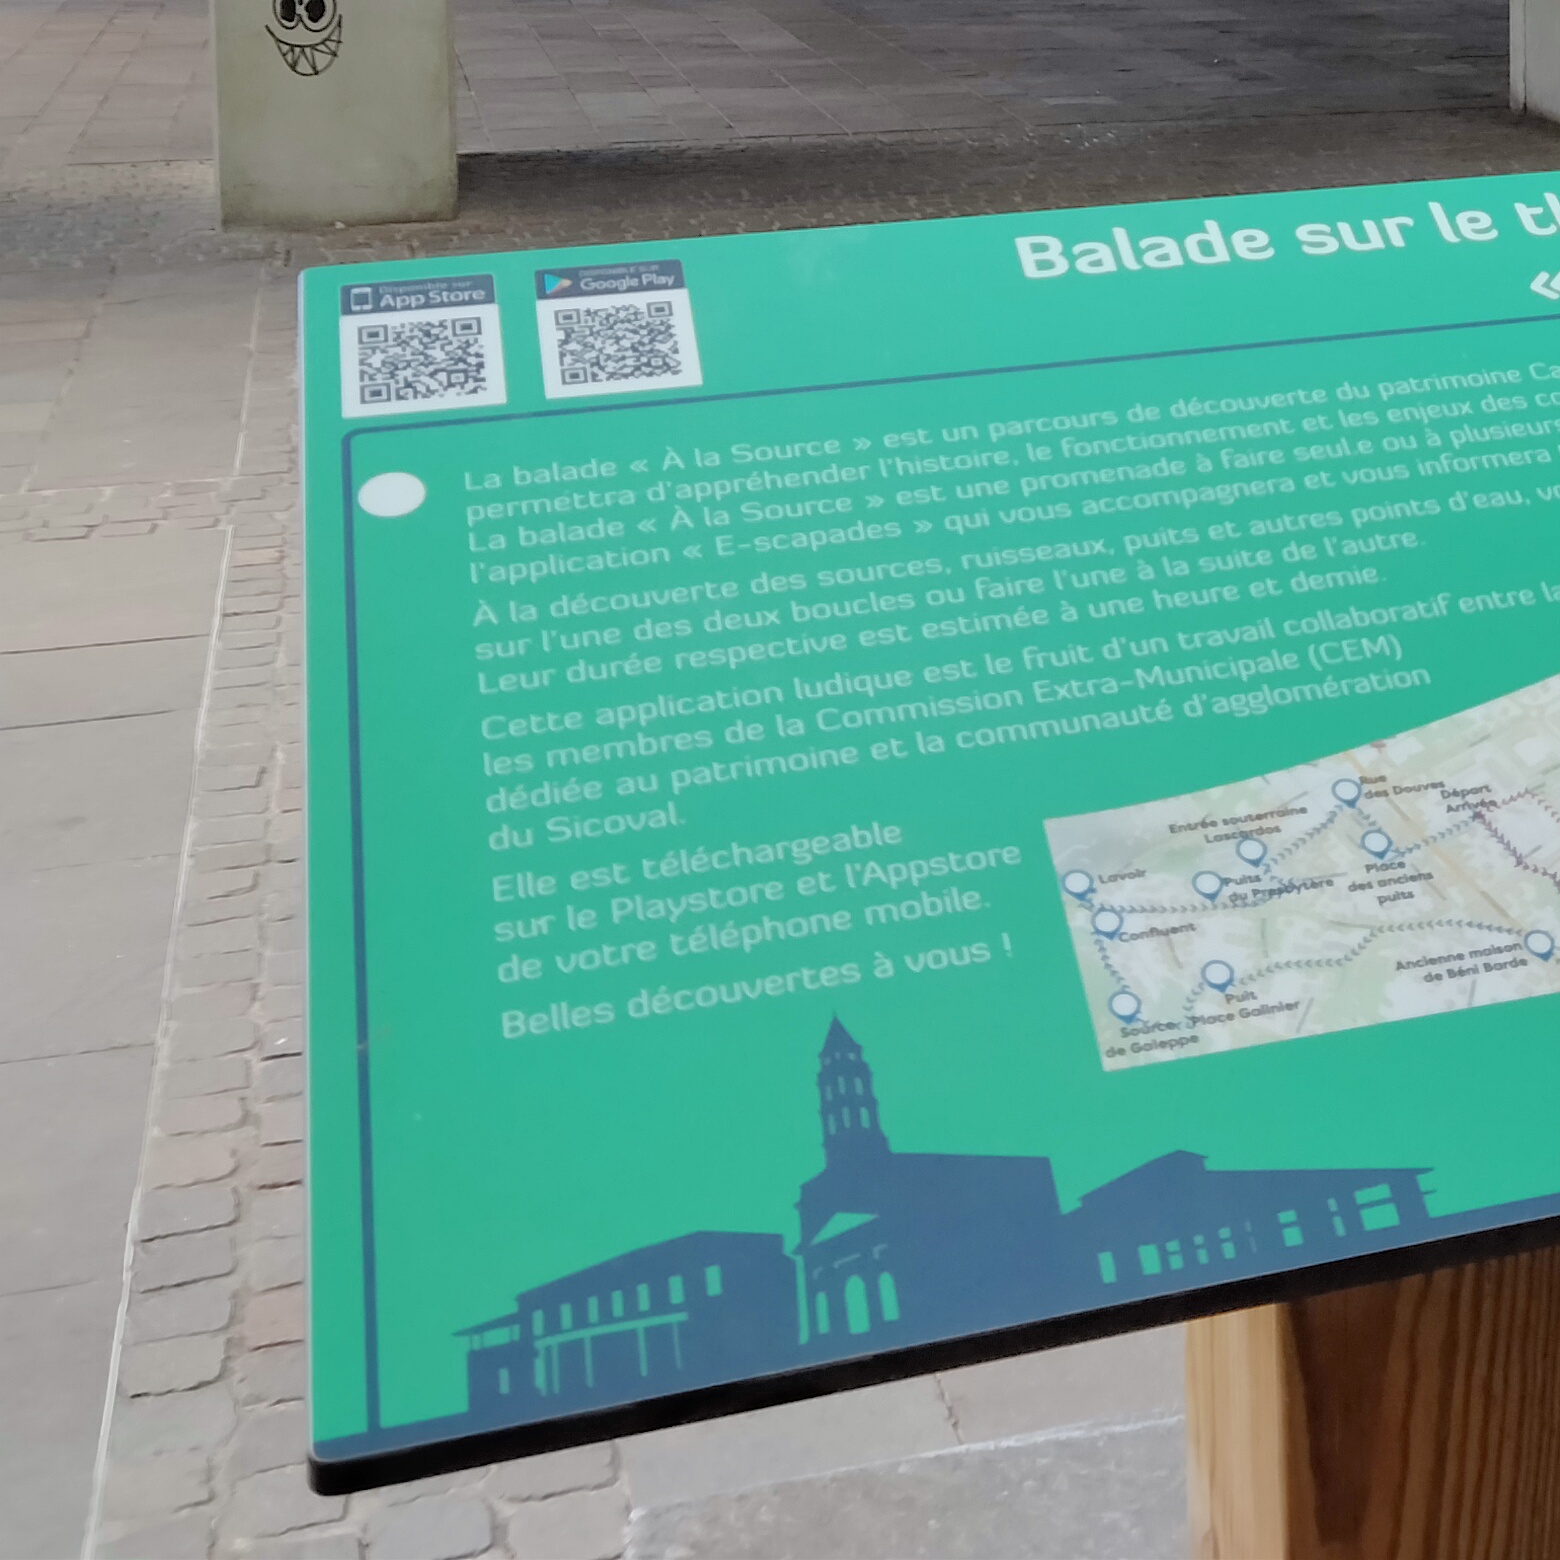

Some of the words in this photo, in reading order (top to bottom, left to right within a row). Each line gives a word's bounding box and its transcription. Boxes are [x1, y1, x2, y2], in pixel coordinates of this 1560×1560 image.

[580, 276, 639, 291] Google
[641, 273, 675, 287] Play
[1015, 220, 1274, 278] Balade
[1296, 217, 1413, 254] sur
[1429, 202, 1498, 242] le
[380, 294, 426, 309] App
[428, 289, 486, 304] Store
[464, 472, 502, 491] La
[513, 458, 617, 486] balade
[663, 446, 685, 471] À
[694, 448, 721, 468] la
[883, 429, 933, 448] est
[942, 426, 979, 442] un
[988, 411, 1118, 442] parcours
[1127, 403, 1161, 423] de
[1169, 389, 1327, 418] découverte
[1336, 381, 1370, 401] du
[1377, 369, 1522, 401] patrimoine
[466, 490, 636, 528] permettra
[646, 463, 871, 503] d'appréhender
[879, 451, 1018, 478] l'histoire,
[1026, 443, 1052, 462] le
[1061, 419, 1294, 457] fonctionnement
[1302, 415, 1333, 432] et
[1338, 410, 1379, 427] les
[1387, 401, 1473, 424] enjeux
[1481, 394, 1528, 413] des
[470, 548, 671, 585] l'application
[715, 520, 902, 556] E-scapades
[944, 511, 990, 535] qui
[999, 503, 1072, 524] vous
[1082, 477, 1296, 515] accompagnera
[1303, 471, 1336, 490] et
[1342, 465, 1410, 485] vous
[1417, 449, 1552, 476] informera
[481, 712, 583, 740] Cette
[595, 686, 784, 729] application
[793, 670, 913, 700] ludique
[923, 660, 977, 683] est
[984, 653, 1013, 675] le
[1022, 645, 1094, 670] fruit
[1101, 637, 1169, 660] d'un
[1177, 617, 1276, 650] travail
[1283, 592, 1451, 636] collaboratif
[1458, 589, 1536, 614] entre
[483, 752, 534, 777] les
[547, 730, 713, 768] membres
[725, 720, 765, 744] de
[776, 714, 805, 737] la
[816, 690, 1024, 731] Commission
[1032, 650, 1299, 703] Extra-Municipale
[1308, 634, 1402, 671] (CEM)
[486, 778, 602, 813] dédiée
[616, 774, 659, 796] au
[671, 747, 859, 795] patrimoine
[870, 738, 908, 761] et
[916, 732, 945, 755] la
[956, 698, 1174, 749] communauté
[1183, 668, 1431, 718] d'agglomération
[488, 824, 534, 852] du
[546, 801, 686, 843] Sicoval.
[492, 872, 556, 902] Elle
[570, 863, 630, 891] est
[642, 821, 903, 880] téléchargeable
[494, 915, 555, 942] sur
[567, 905, 597, 931] le
[611, 881, 784, 924] Playstore
[797, 872, 836, 896] et
[845, 846, 1022, 888] l'Appstore
[497, 954, 542, 984] de
[555, 941, 657, 974] votre
[670, 910, 852, 956] téléphone
[864, 888, 990, 925] mobile.
[501, 1001, 616, 1039] Belles
[627, 963, 862, 1019] découvertes
[873, 951, 895, 979] à
[904, 942, 991, 973] vous
